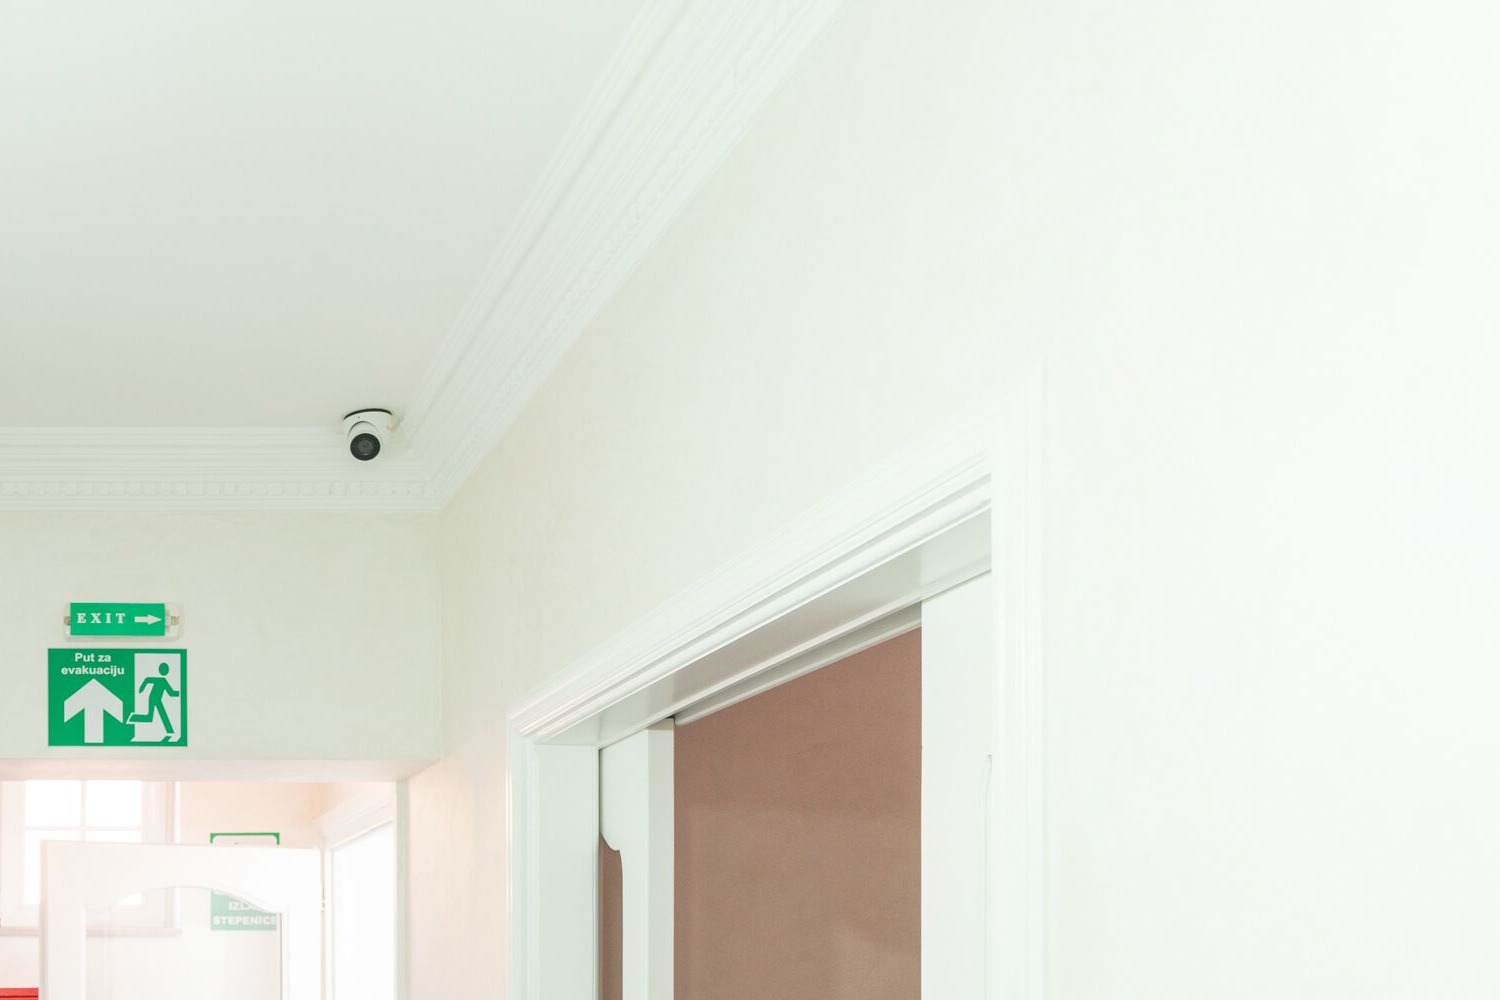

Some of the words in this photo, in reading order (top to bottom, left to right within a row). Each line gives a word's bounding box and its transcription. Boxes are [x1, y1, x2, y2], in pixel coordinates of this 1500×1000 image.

[76, 612, 126, 624] EXIT
[74, 652, 95, 663] Put
[97, 654, 112, 663] za
[60, 665, 125, 677] evakuaciju
[212, 915, 277, 925] STEPENICE
